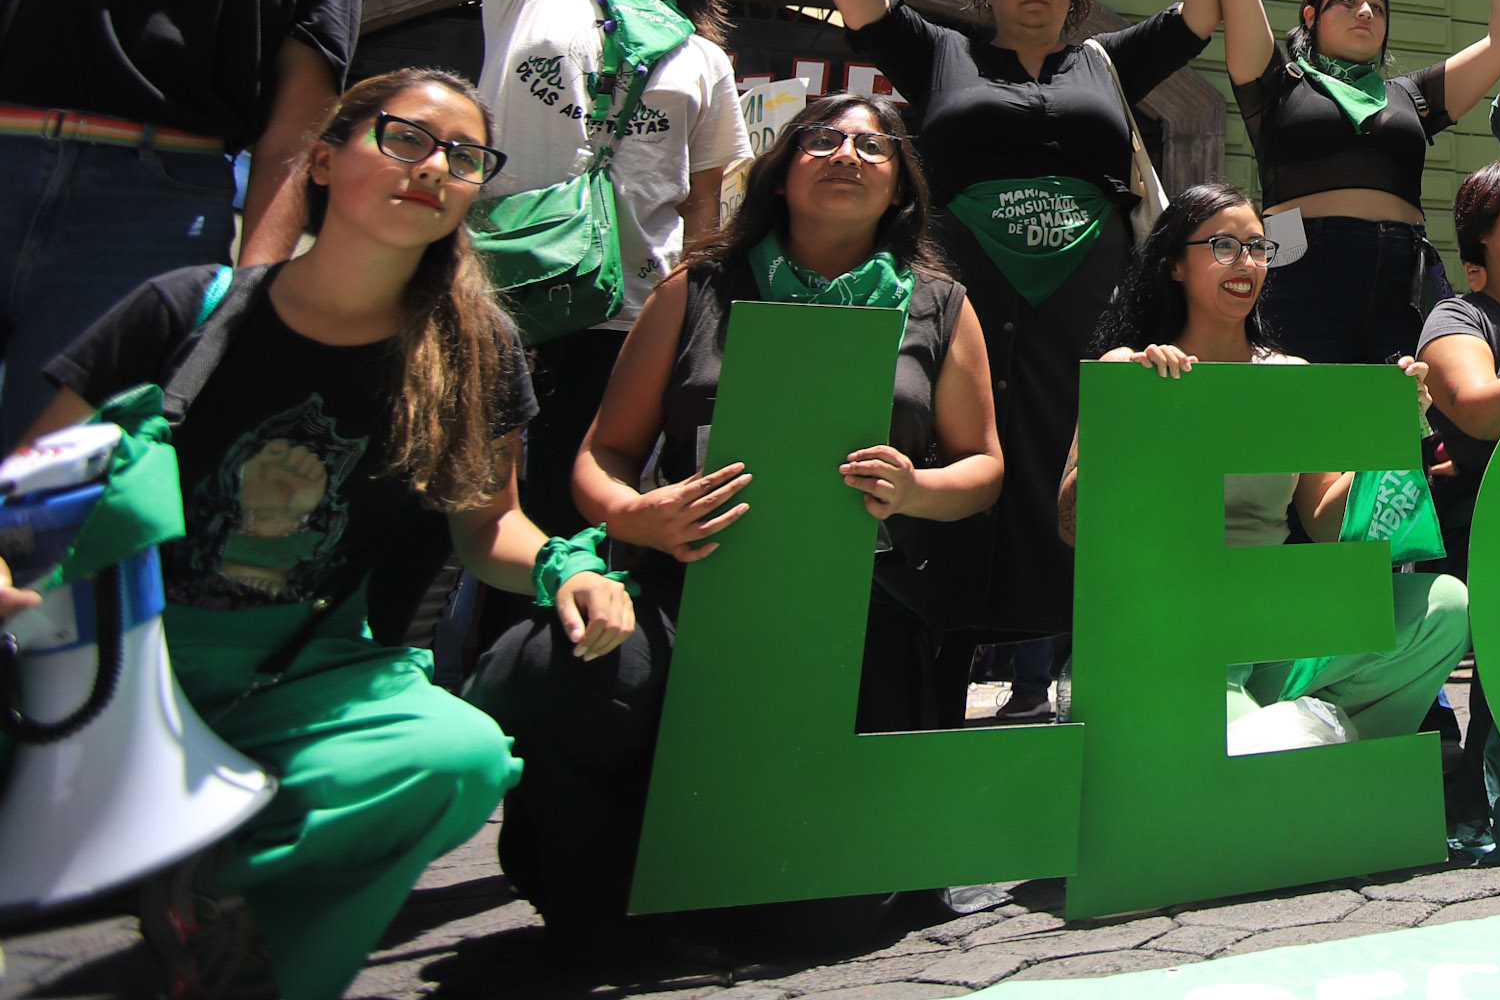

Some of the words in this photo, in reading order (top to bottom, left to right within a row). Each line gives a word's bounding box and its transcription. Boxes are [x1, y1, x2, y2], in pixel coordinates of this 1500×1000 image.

[516, 61, 534, 83] DE
[530, 78, 560, 106] LAS
[559, 103, 671, 137] ABRTSTAS
[1039, 209, 1090, 228] MADRE
[1008, 222, 1024, 234] DE
[1026, 224, 1075, 247] DIOS
